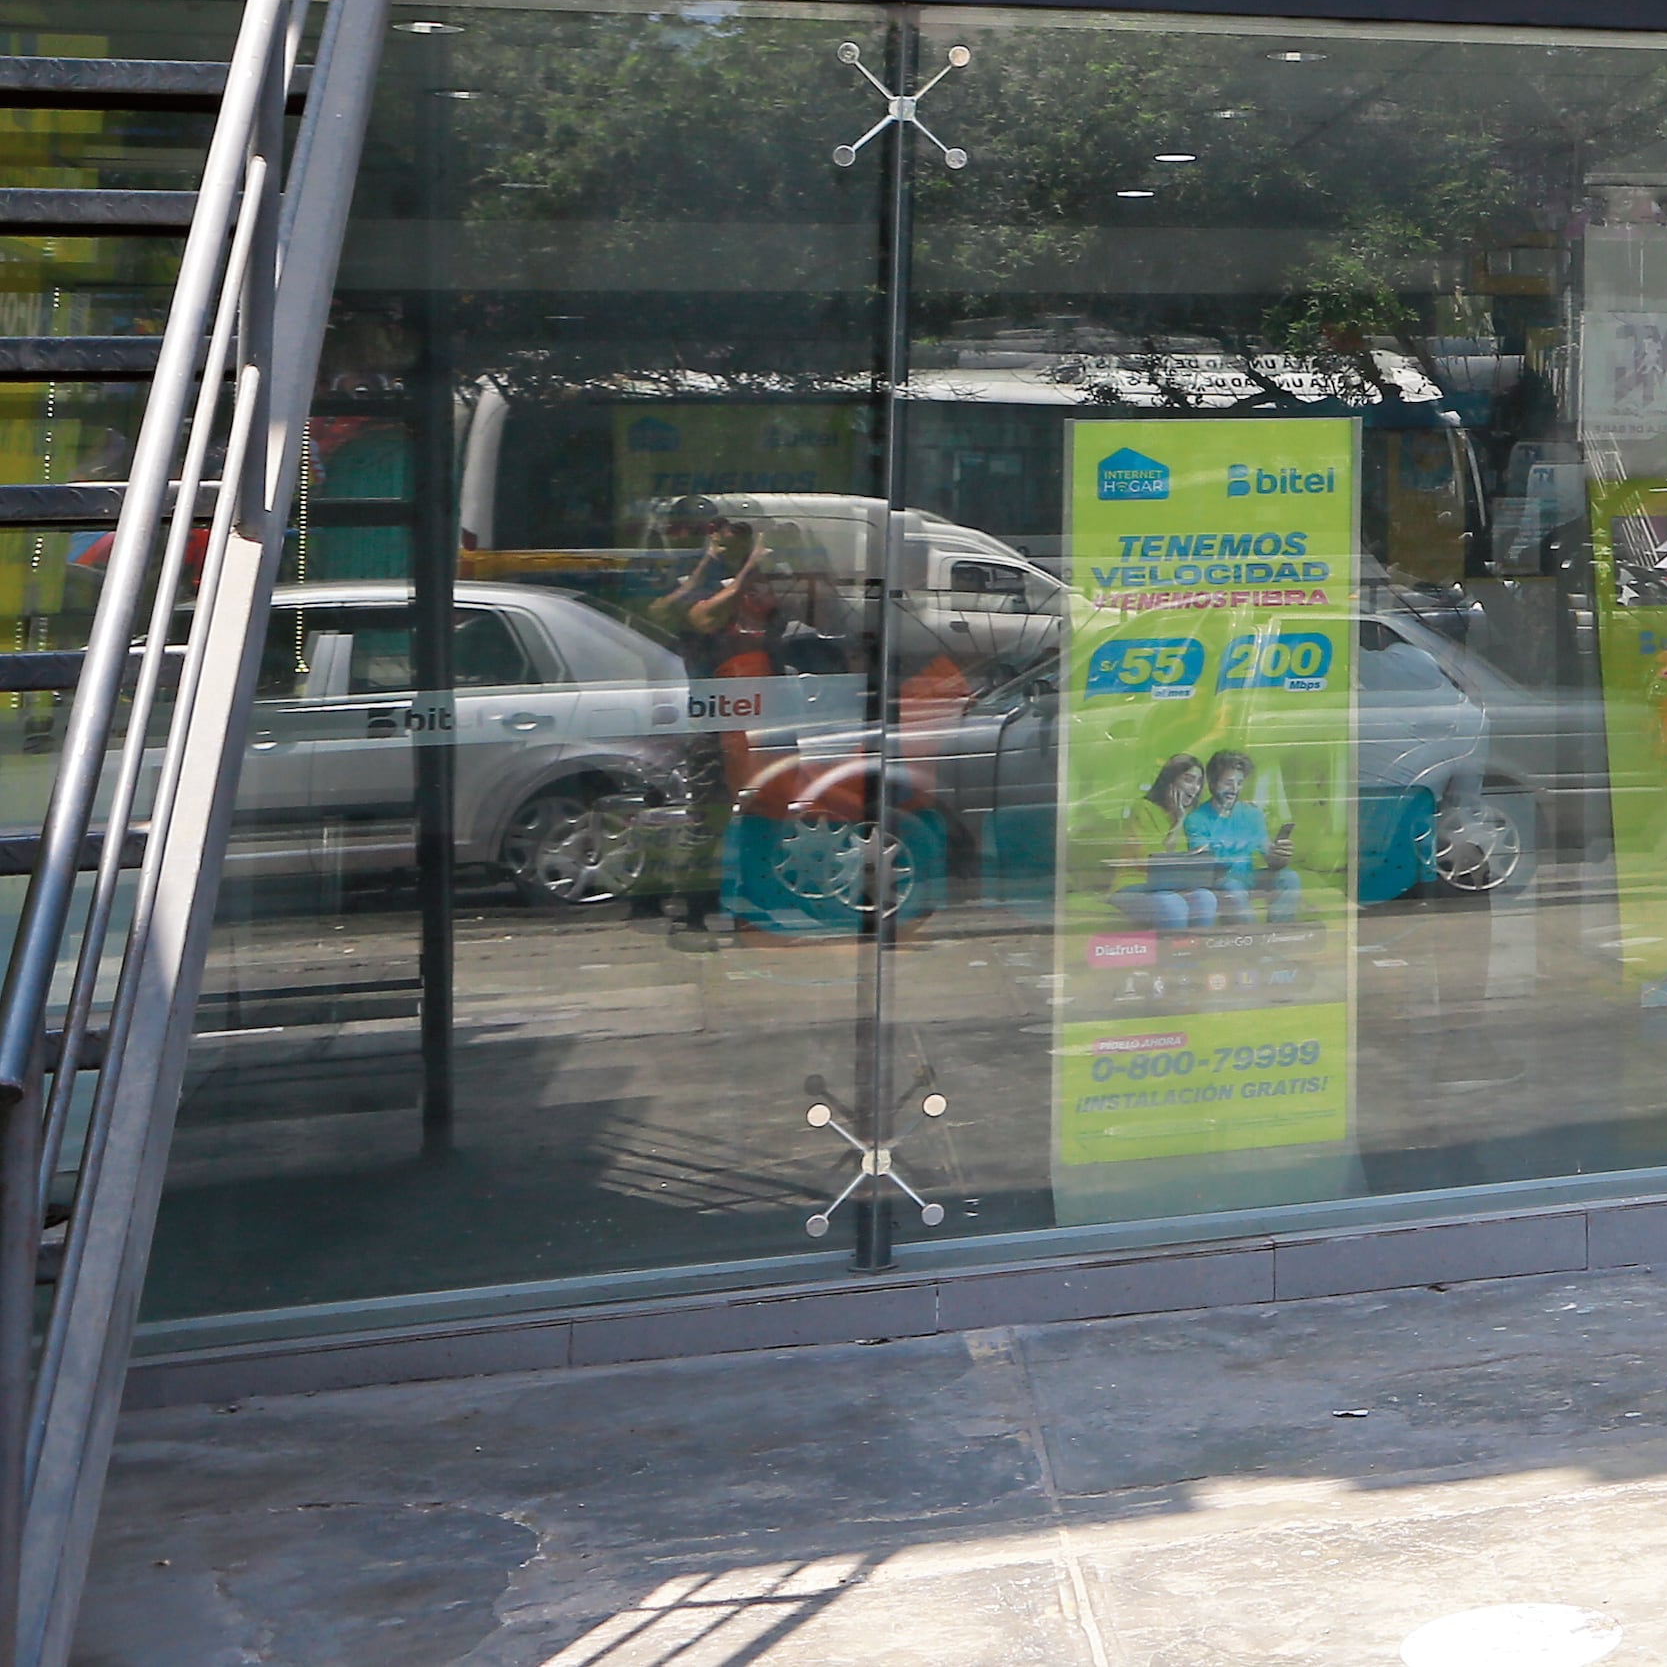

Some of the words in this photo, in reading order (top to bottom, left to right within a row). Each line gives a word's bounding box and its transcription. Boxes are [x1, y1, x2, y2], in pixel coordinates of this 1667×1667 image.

[1104, 470, 1163, 480] INTERNET
[1256, 467, 1335, 494] bitel
[1118, 532, 1308, 564] TENEMOS
[1091, 562, 1331, 588] VELOCIDAD
[1226, 641, 1322, 679] 200
[1288, 679, 1321, 691] Mbps
[687, 693, 762, 720] bitel
[1095, 944, 1148, 957] Disfruta
[1240, 1075, 1329, 1100] GRATIS!
